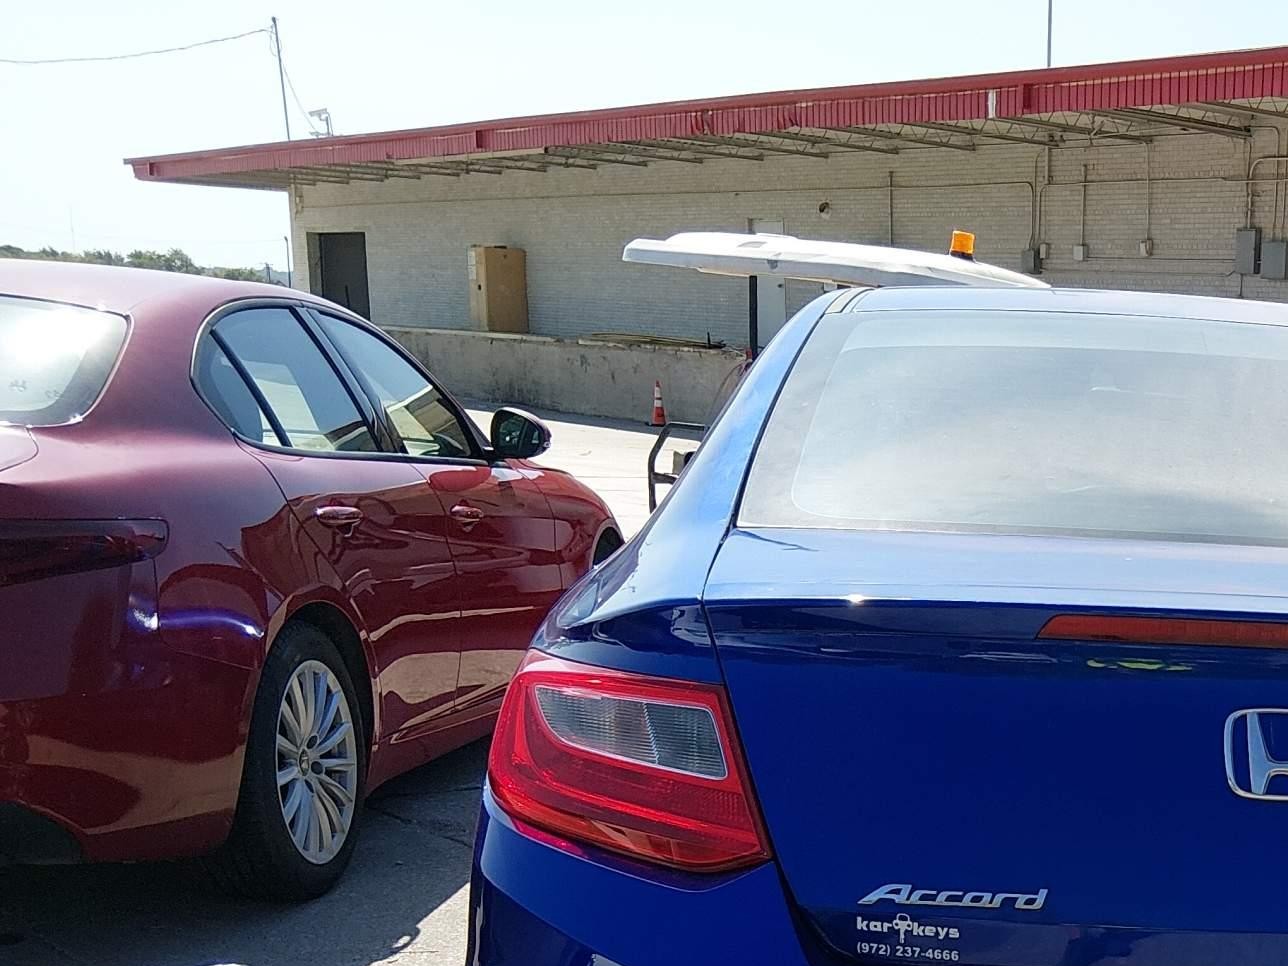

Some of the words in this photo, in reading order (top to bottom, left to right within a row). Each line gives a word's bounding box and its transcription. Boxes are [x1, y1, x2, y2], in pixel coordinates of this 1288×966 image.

[857, 883, 1048, 910] Accord
[856, 916, 893, 933] kar
[912, 922, 960, 939] keys
[857, 941, 891, 957] (972)
[895, 945, 959, 961] 237-4666
